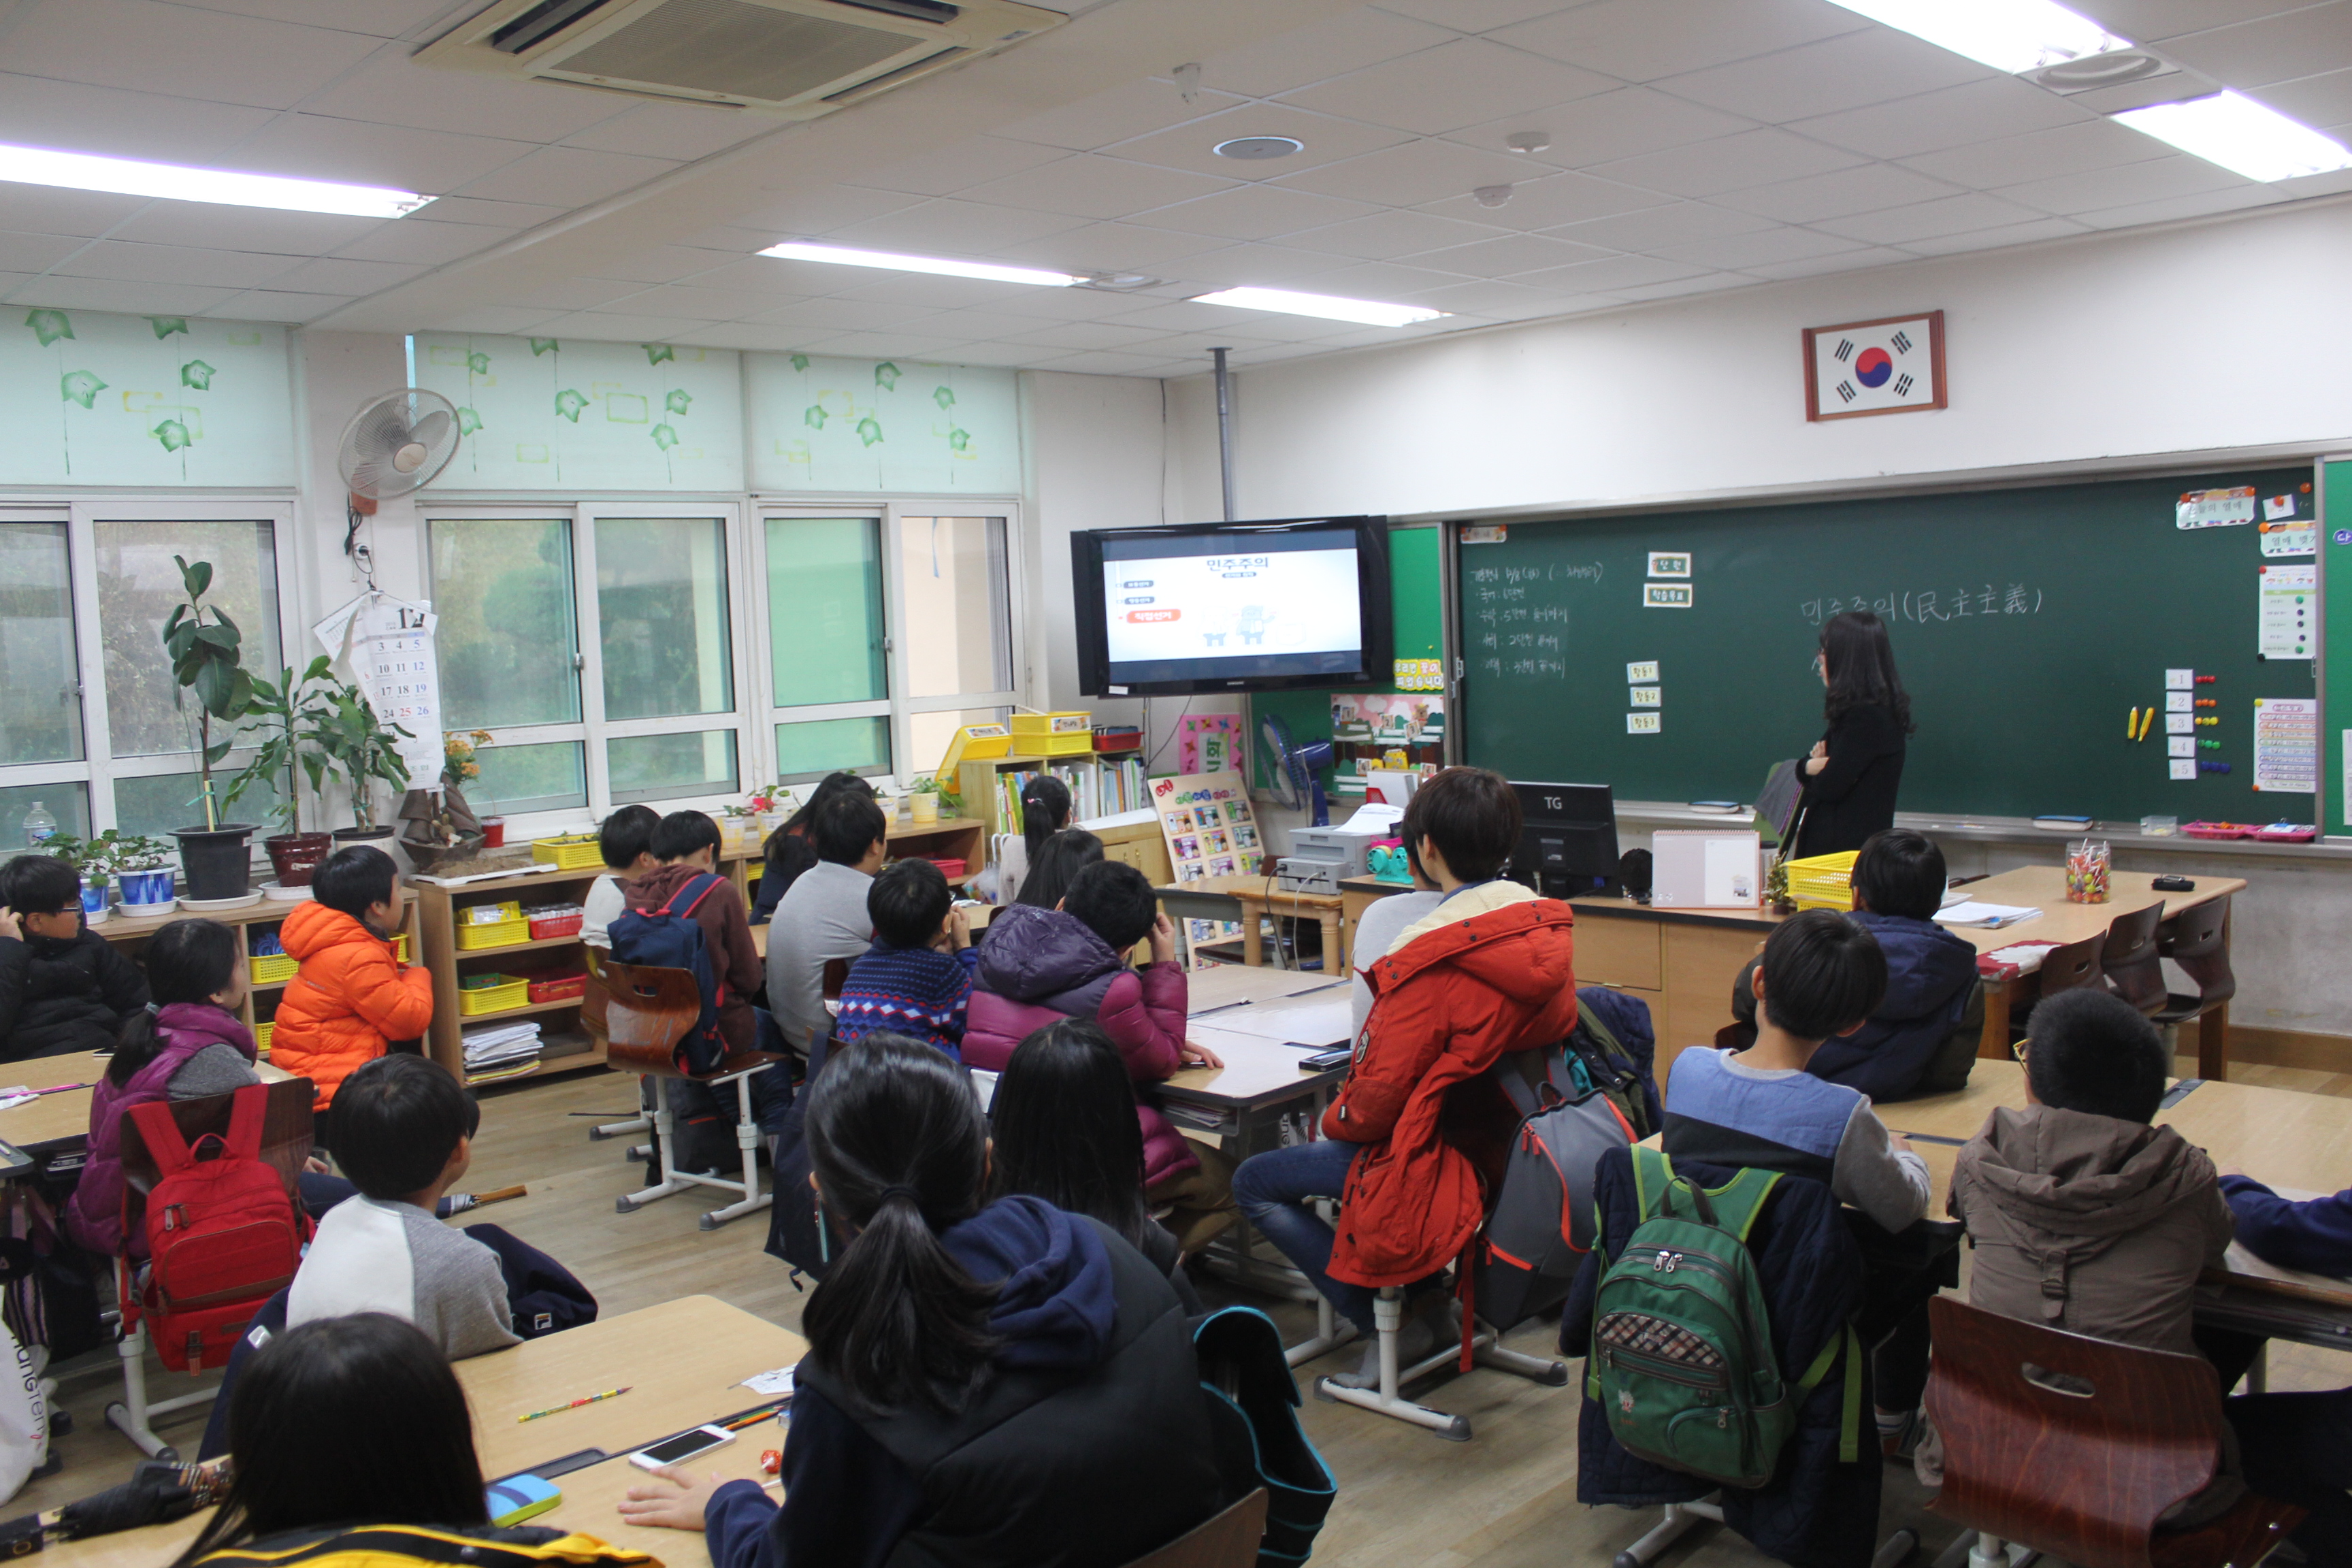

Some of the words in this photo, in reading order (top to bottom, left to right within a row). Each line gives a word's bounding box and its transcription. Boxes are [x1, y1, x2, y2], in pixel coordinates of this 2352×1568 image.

[1206, 557, 1269, 572] 민주주의
[1134, 611, 1172, 621] 직접선거
[378, 642, 385, 651] 3
[396, 640, 402, 649] 4
[414, 639, 421, 649] 5
[378, 664, 390, 674] 10
[396, 663, 406, 672] 11
[414, 662, 425, 671] 12
[2179, 674, 2184, 685] 1
[381, 687, 391, 696] 17
[397, 685, 409, 695] 18
[415, 684, 427, 693] 19
[2178, 697, 2185, 707] 2
[383, 709, 394, 718] 24
[399, 707, 412, 717] 25
[417, 706, 429, 715] 26
[2178, 719, 2185, 729] 3
[2180, 742, 2186, 752] 4
[2181, 765, 2188, 774] 5
[1544, 796, 1563, 810] TG
